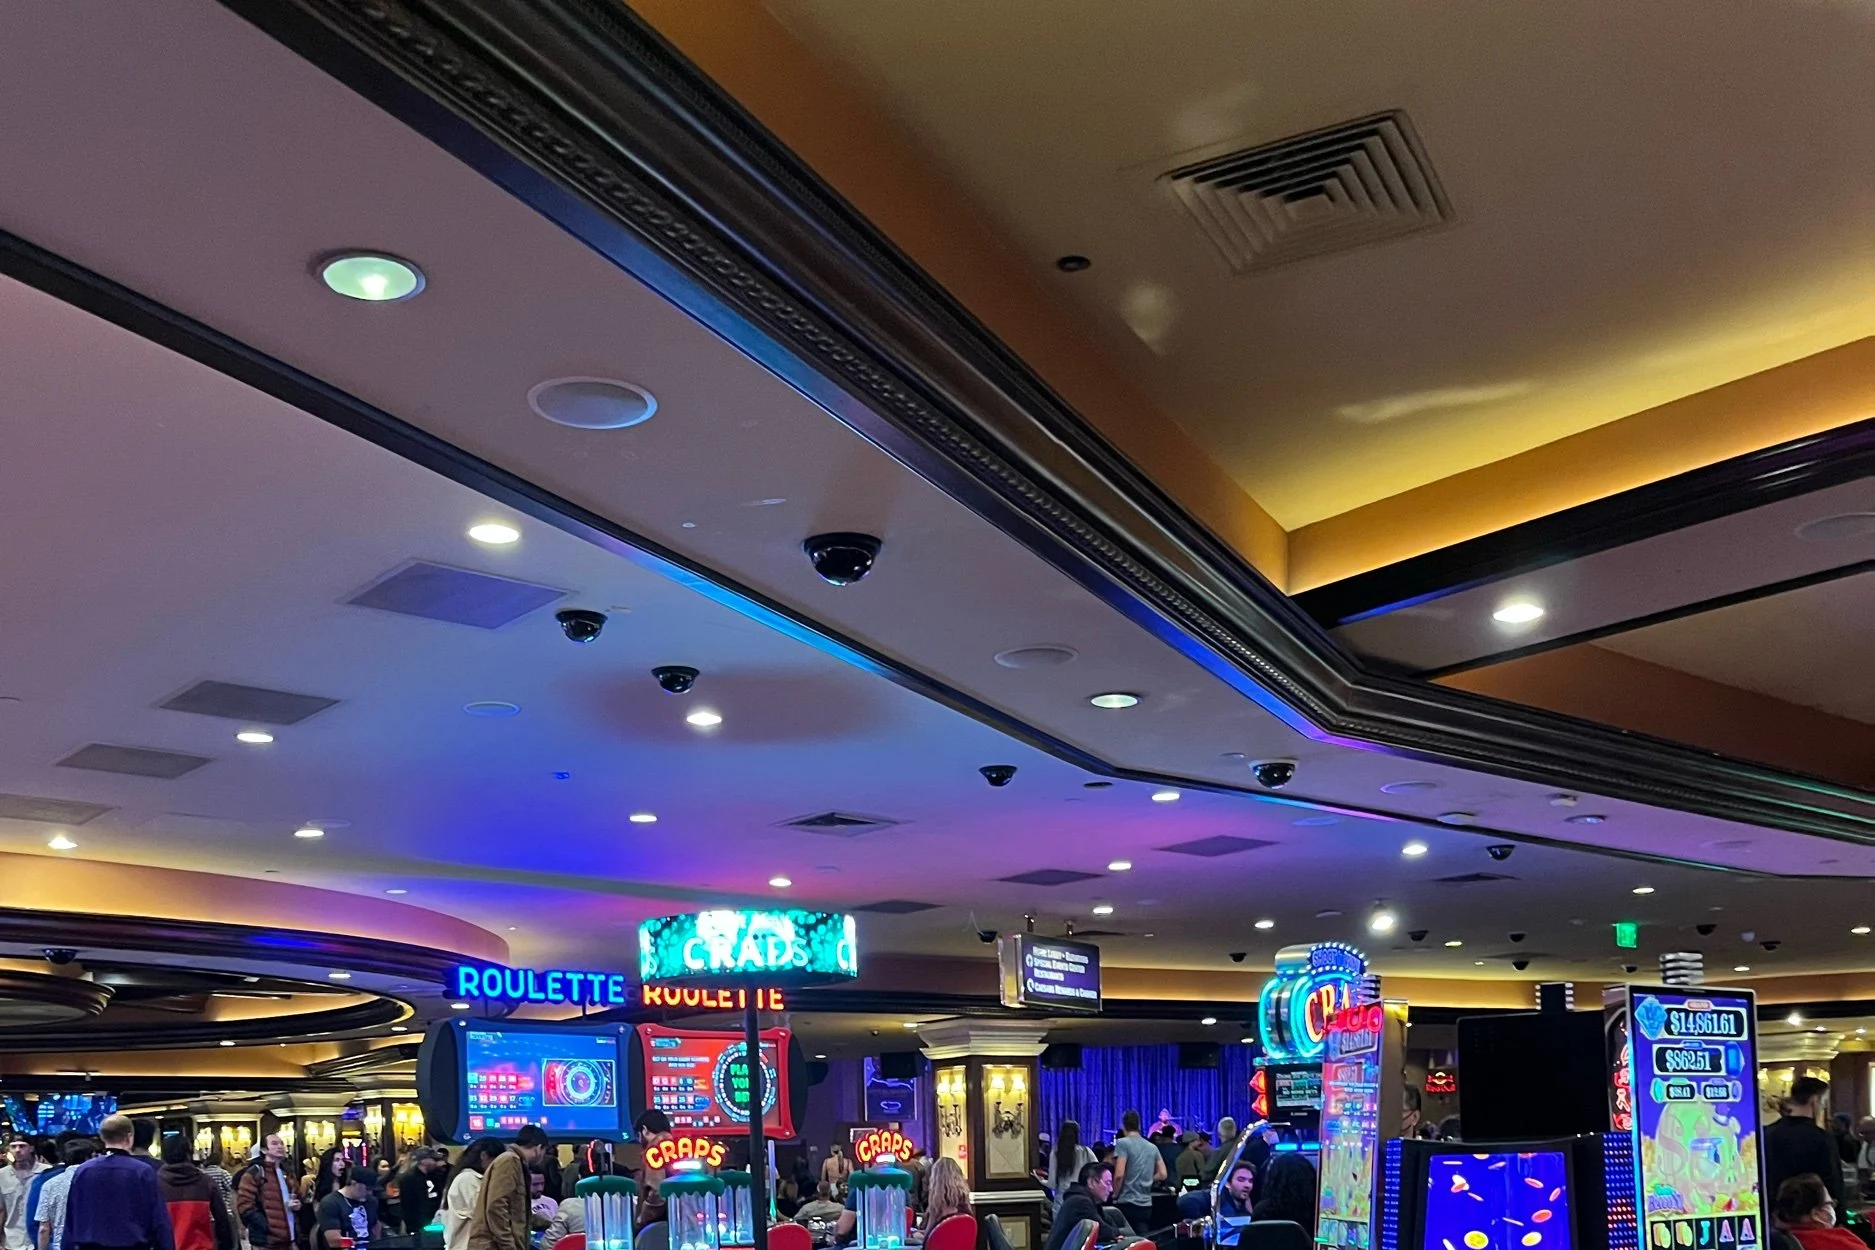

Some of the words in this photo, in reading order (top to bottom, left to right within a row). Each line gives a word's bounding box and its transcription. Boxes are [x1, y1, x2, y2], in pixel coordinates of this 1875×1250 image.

[683, 935, 809, 970] CRAPS
[458, 966, 625, 1003] ROULETTE
[1670, 1010, 1737, 1035] $14,861.61
[730, 1064, 749, 1076] PLA
[1665, 1049, 1711, 1072] $862.51
[735, 1090, 750, 1102] BE
[645, 1137, 726, 1169] CRAPS
[858, 1131, 912, 1163] CRAPS
